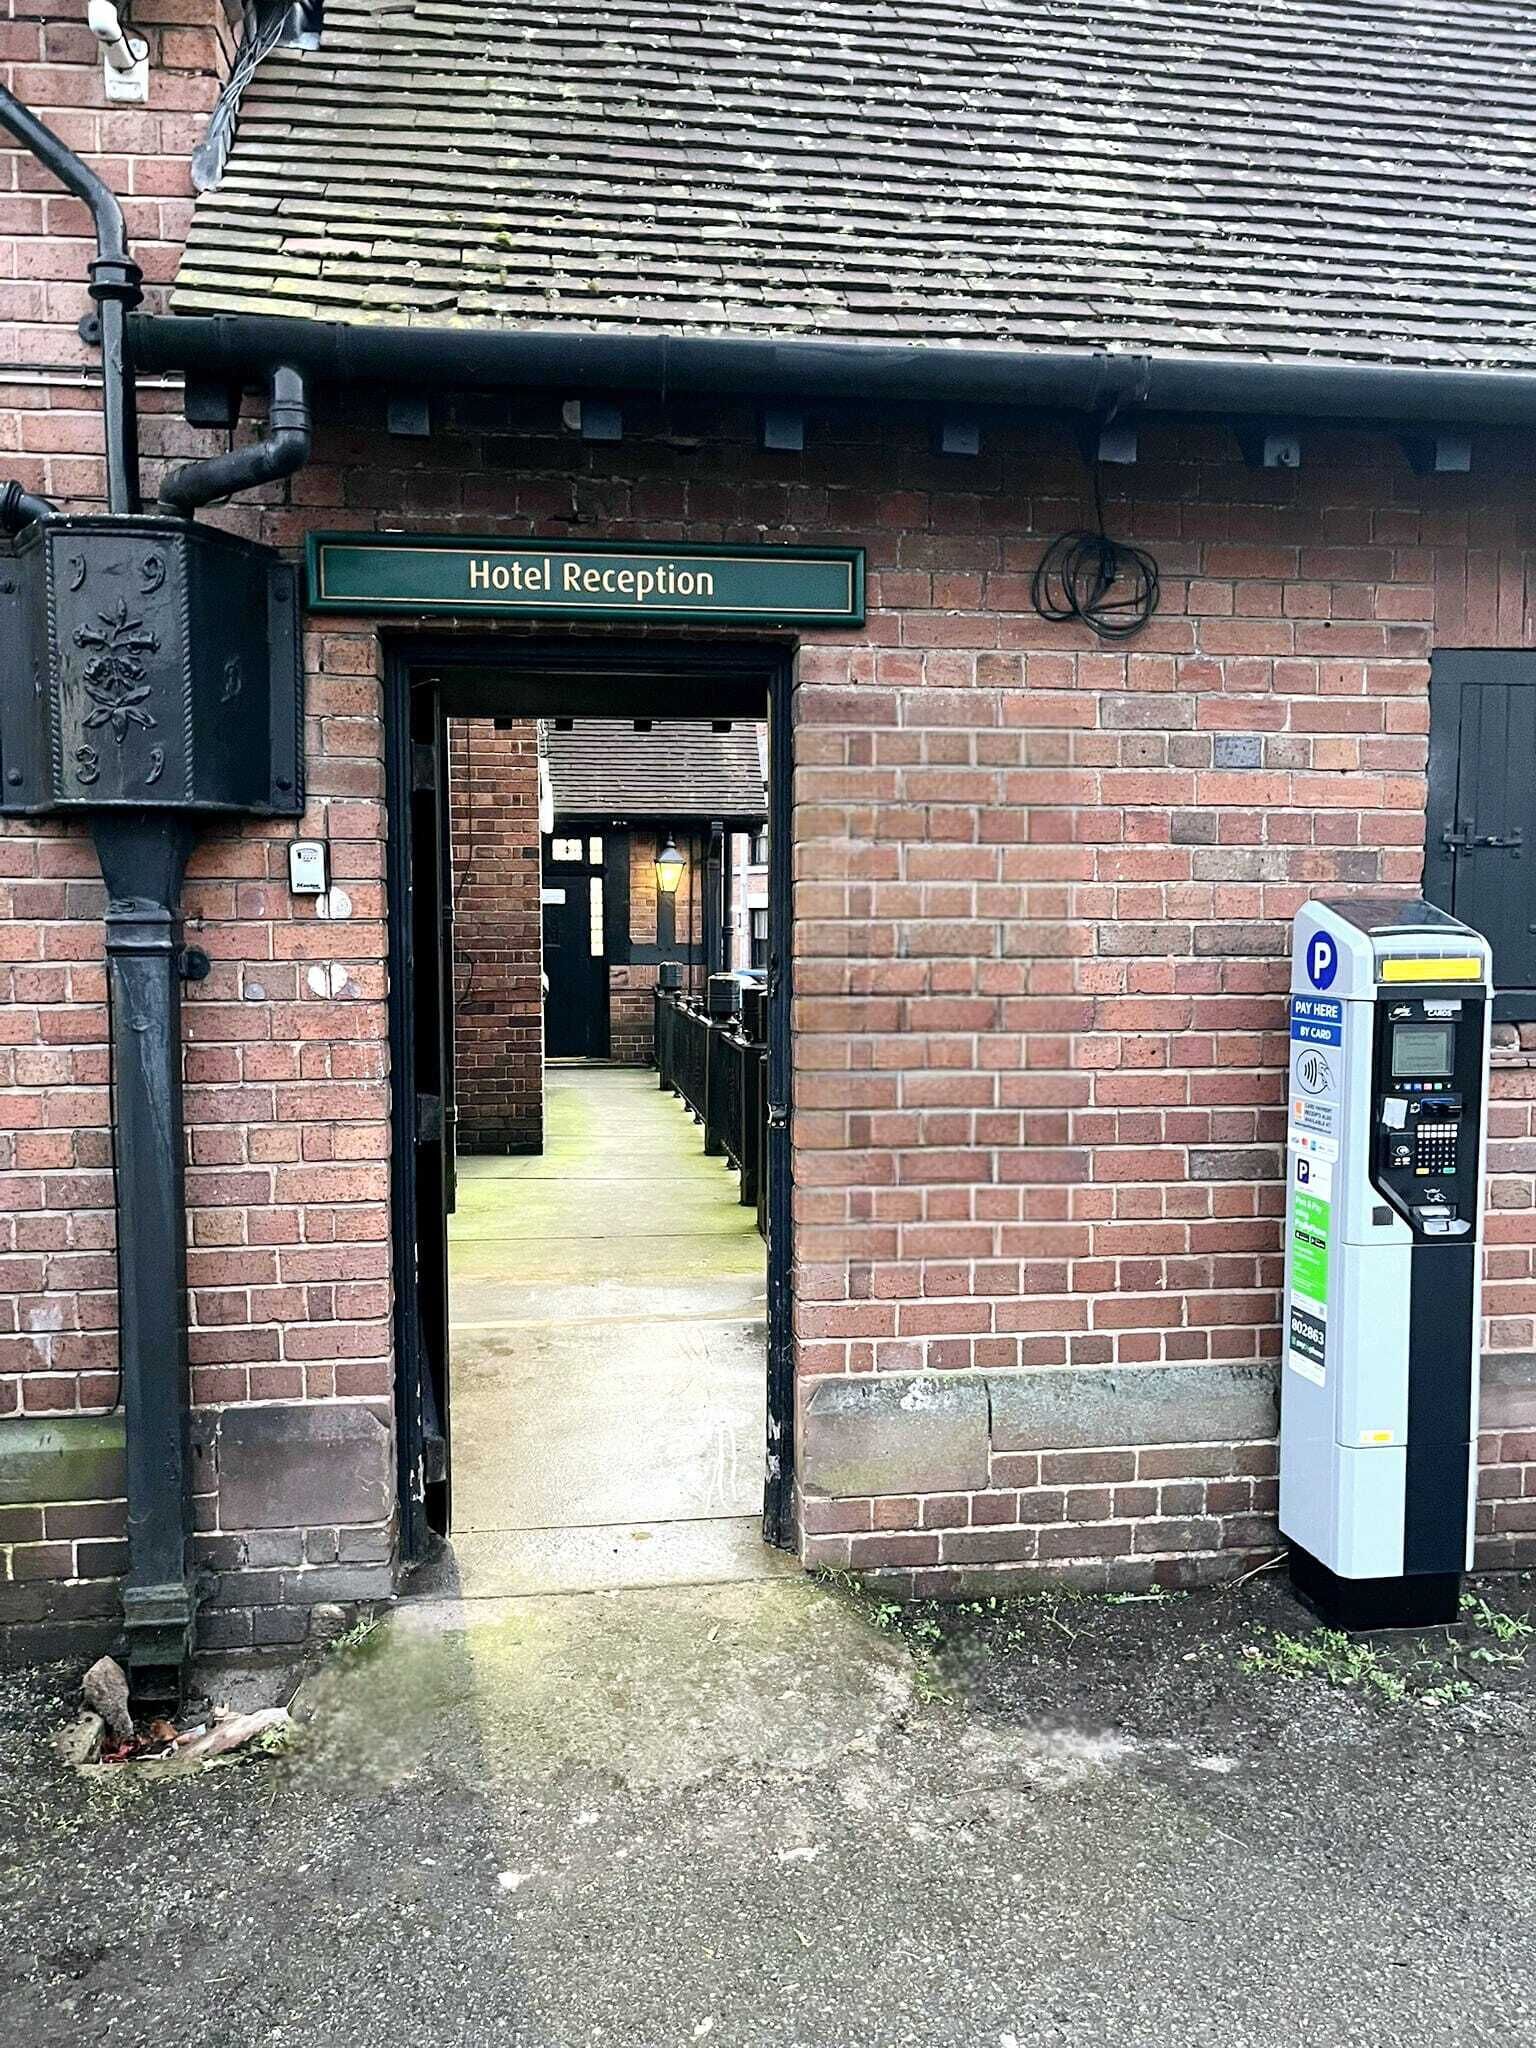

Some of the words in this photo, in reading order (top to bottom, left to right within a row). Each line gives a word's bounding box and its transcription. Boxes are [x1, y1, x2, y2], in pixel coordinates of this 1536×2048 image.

[139, 551, 167, 594] 9
[469, 558, 551, 592] Hotel
[563, 562, 714, 602] Reception
[75, 743, 100, 785] 3
[1313, 941, 1332, 980] P
[1295, 1001, 1313, 1015] PAY
[1313, 1003, 1339, 1018] HERE
[1427, 1009, 1453, 1017] CARDS
[1300, 1025, 1311, 1038] BY
[1310, 1027, 1332, 1041] CARD
[1299, 1161, 1308, 1180] P
[1291, 1317, 1325, 1346] 802863
